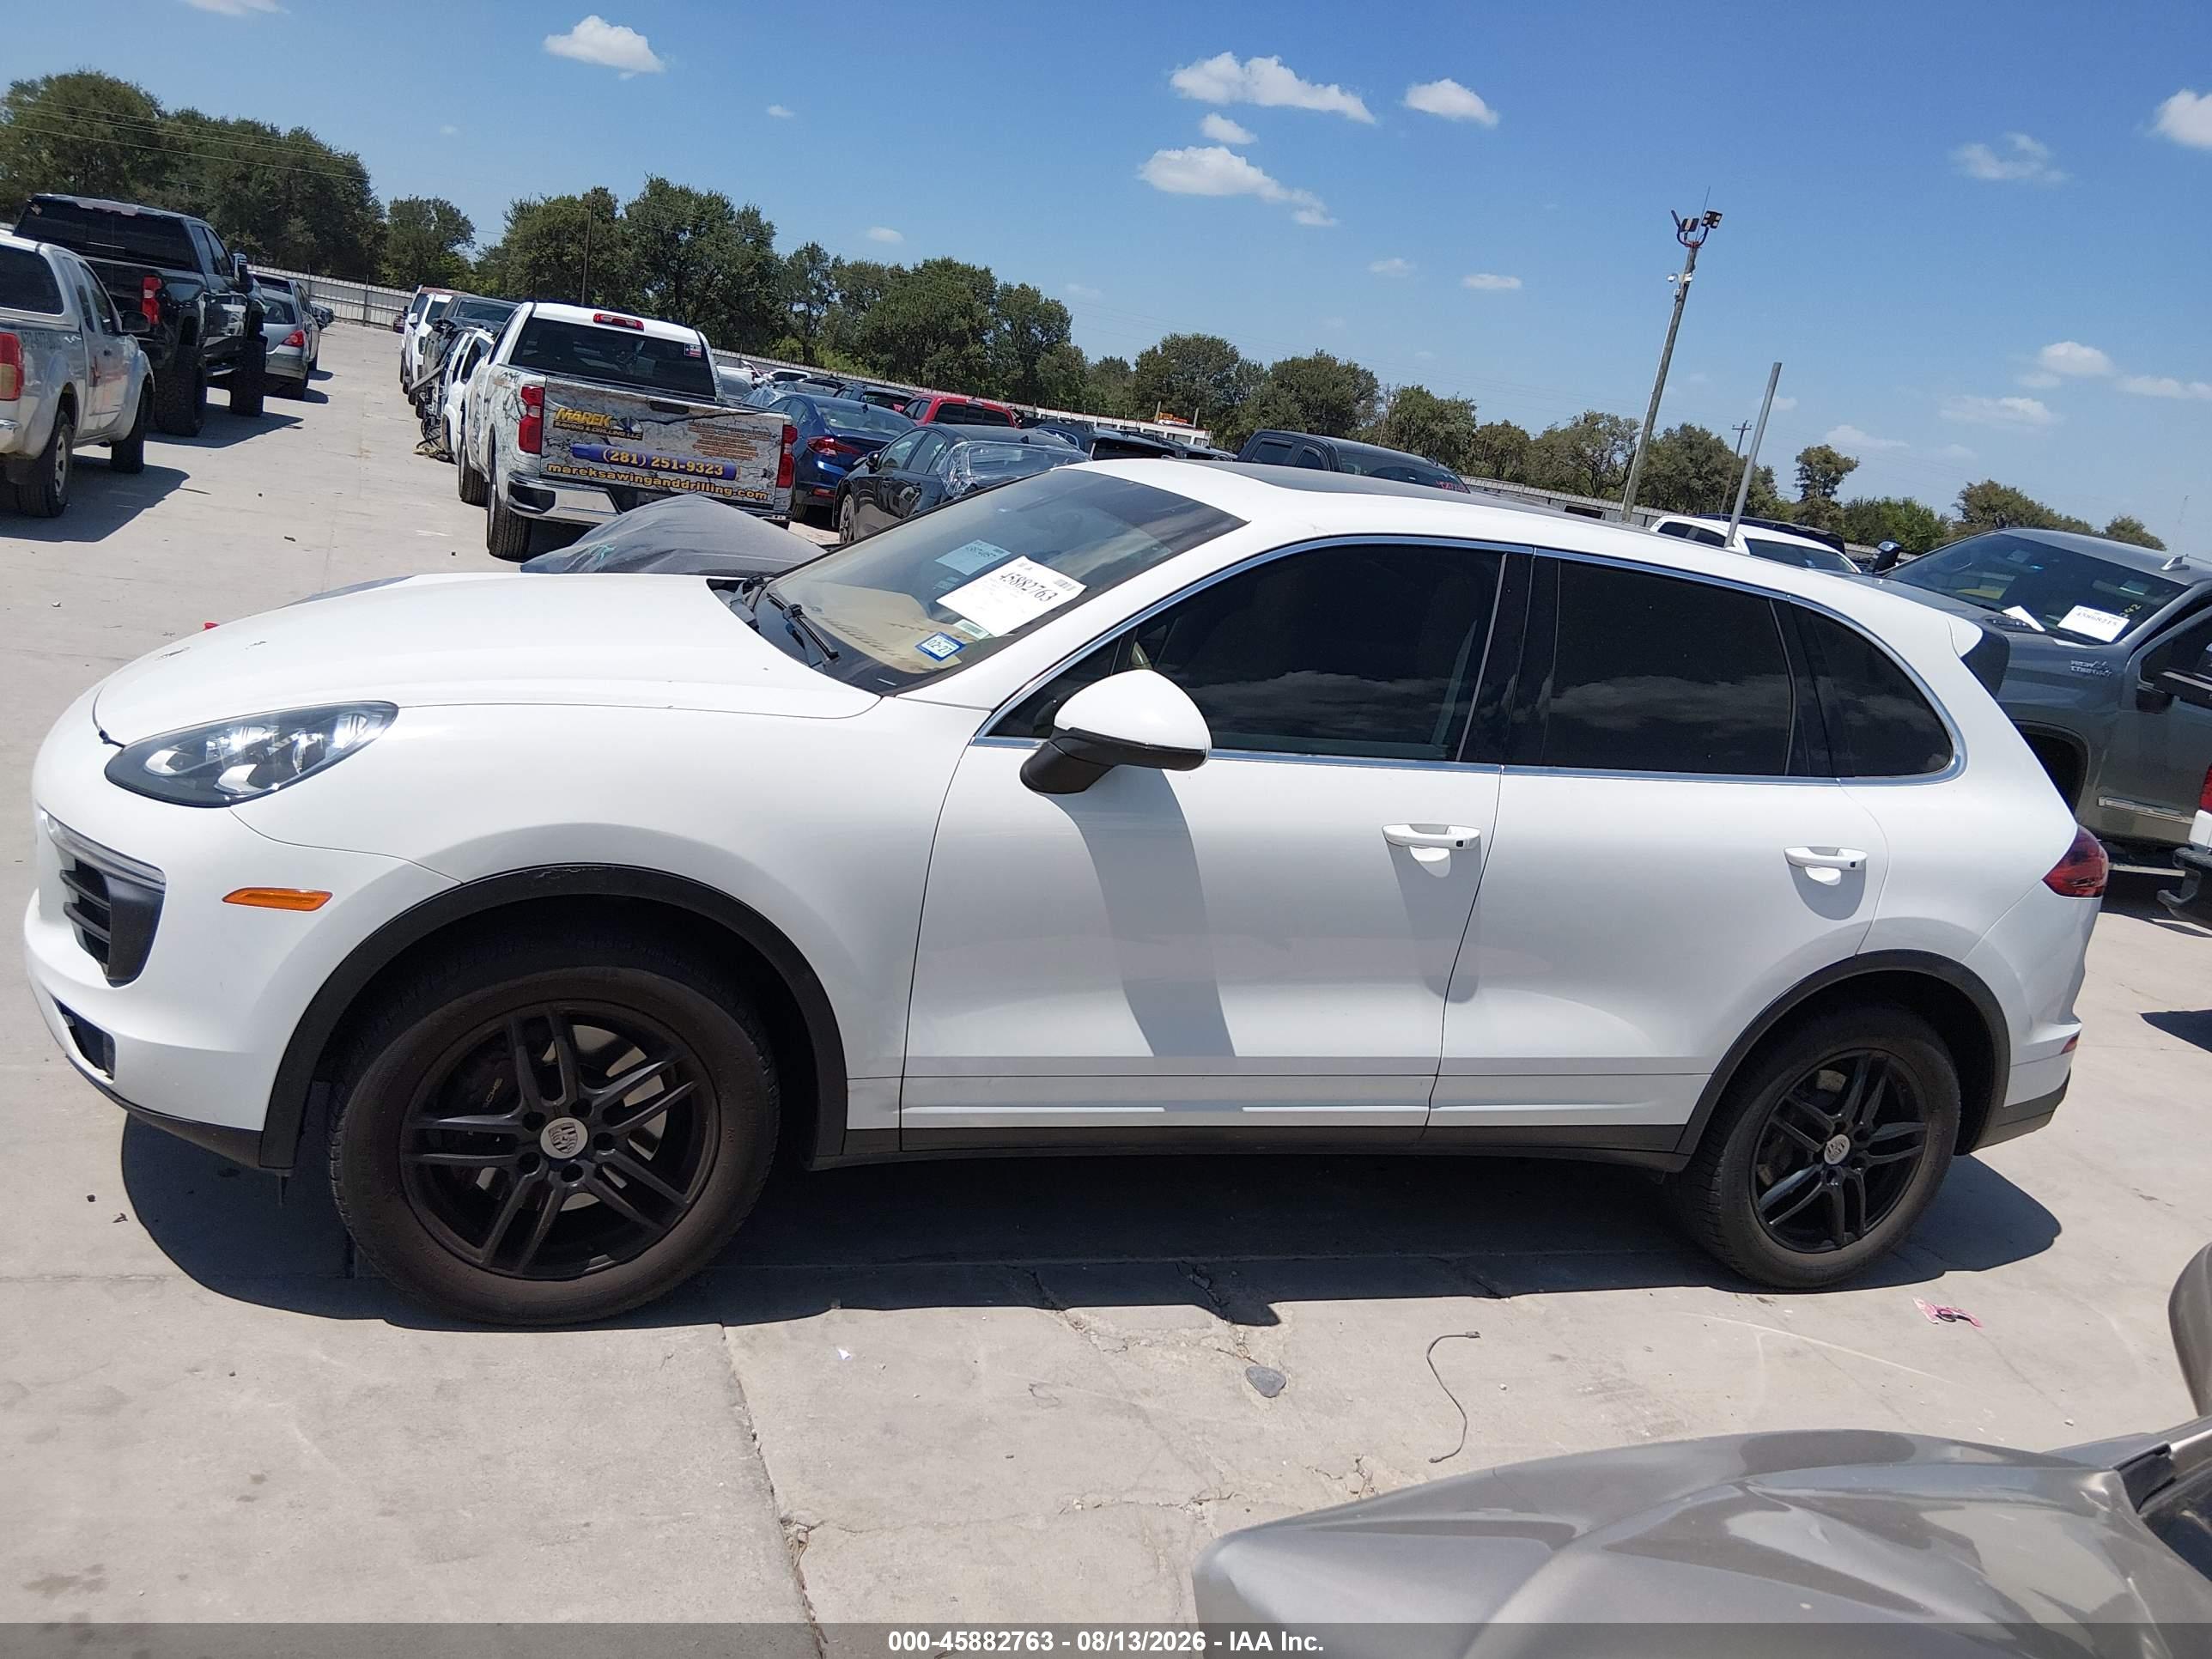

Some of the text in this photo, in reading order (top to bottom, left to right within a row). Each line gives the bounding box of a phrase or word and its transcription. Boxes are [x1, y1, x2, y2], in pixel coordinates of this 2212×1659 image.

[556, 407, 613, 428] MAREK
[592, 427, 625, 437] DRILLING
[603, 447, 724, 476] (281) 251-9323
[548, 464, 769, 501] mareksawinganddrilling.com
[1000, 572, 1059, 602] 45882763
